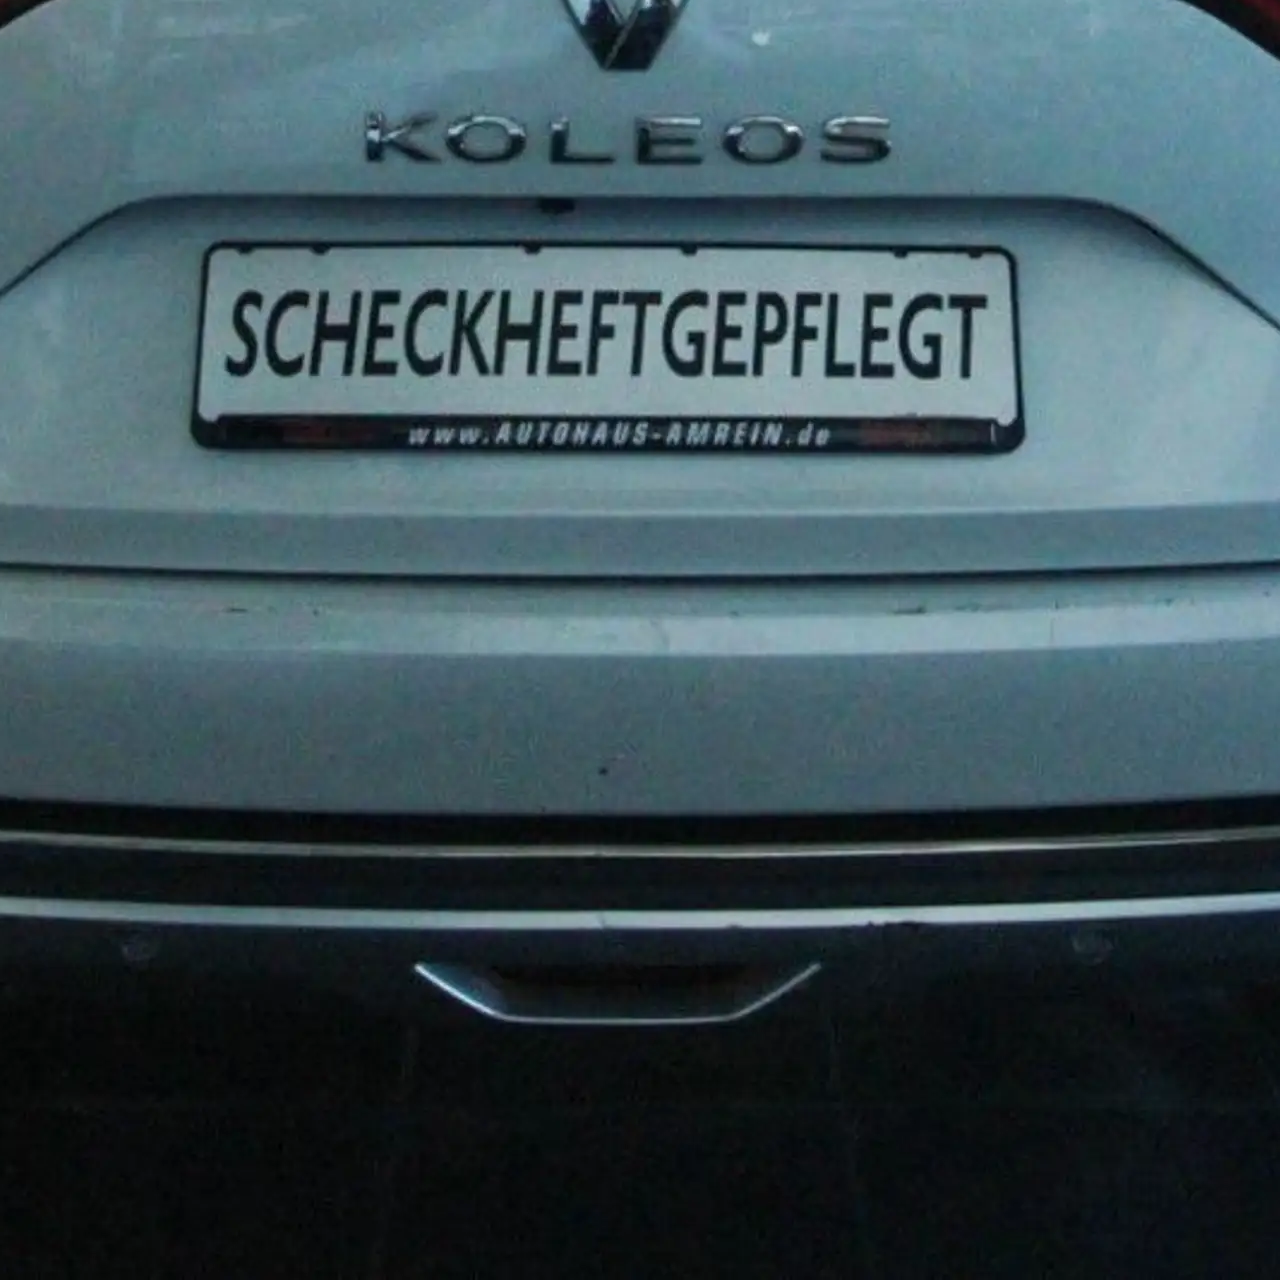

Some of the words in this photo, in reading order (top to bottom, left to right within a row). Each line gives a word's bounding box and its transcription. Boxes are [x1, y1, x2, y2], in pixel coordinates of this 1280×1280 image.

[363, 110, 894, 166] KOLEOS
[223, 287, 988, 380] SCHECKHEFTGEPFLEGT
[407, 420, 831, 447] www.AUTOHAUS-AMREIN.de
